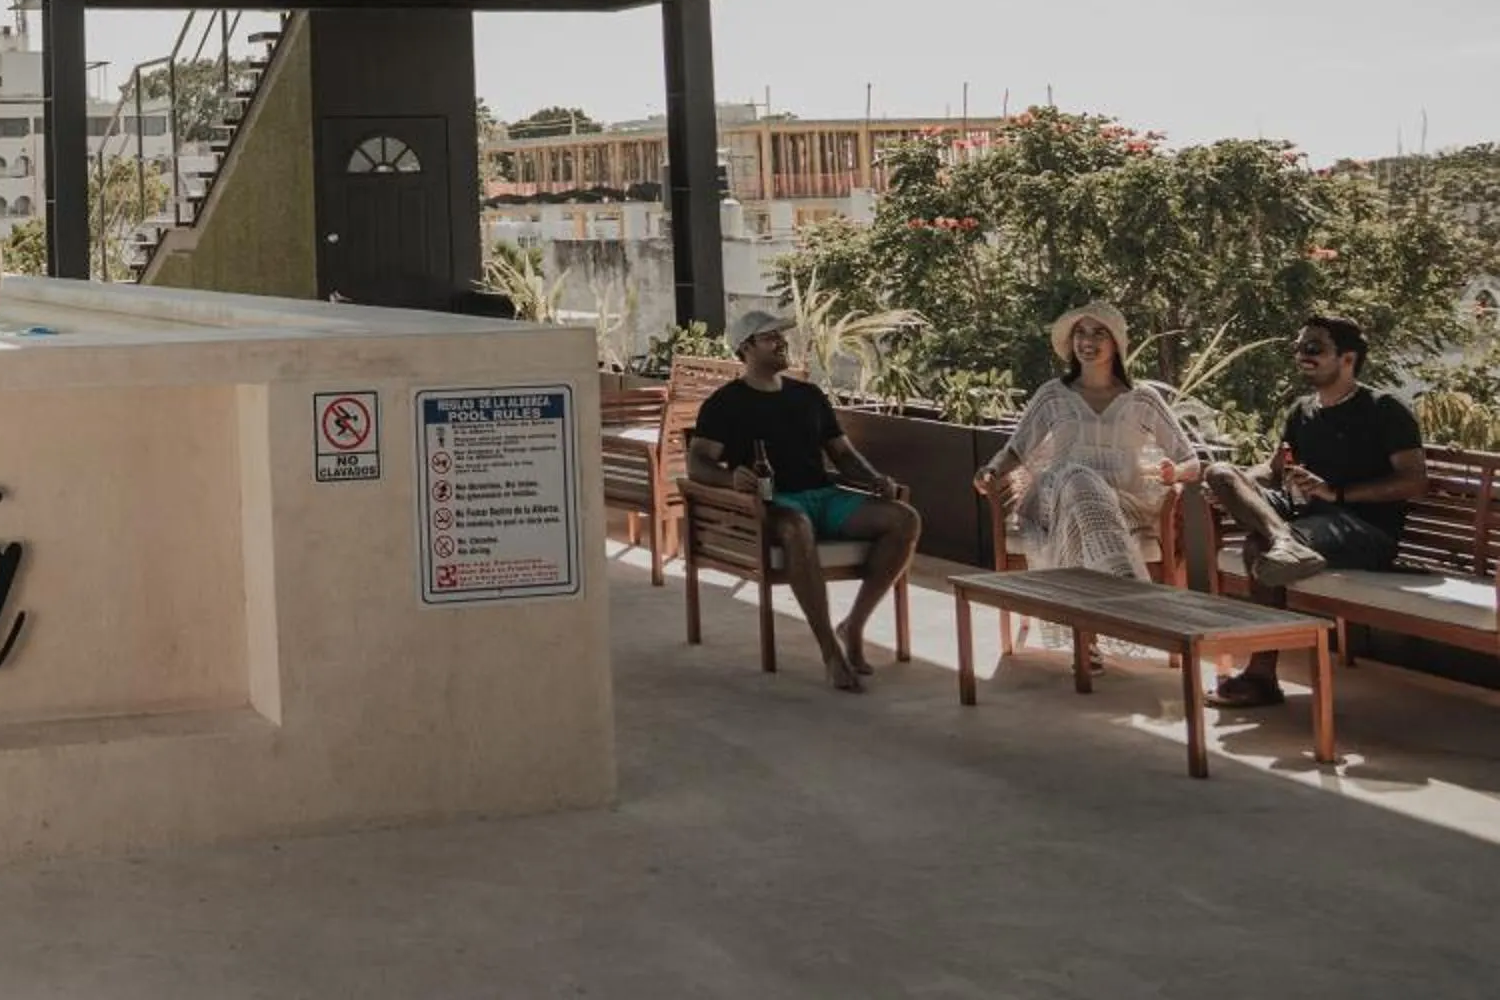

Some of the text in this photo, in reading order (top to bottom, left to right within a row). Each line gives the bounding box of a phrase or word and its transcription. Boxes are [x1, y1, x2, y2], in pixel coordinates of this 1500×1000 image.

[448, 407, 541, 421] POOL RULES
[337, 455, 359, 466] NO
[319, 466, 376, 477] CLAVADOS
